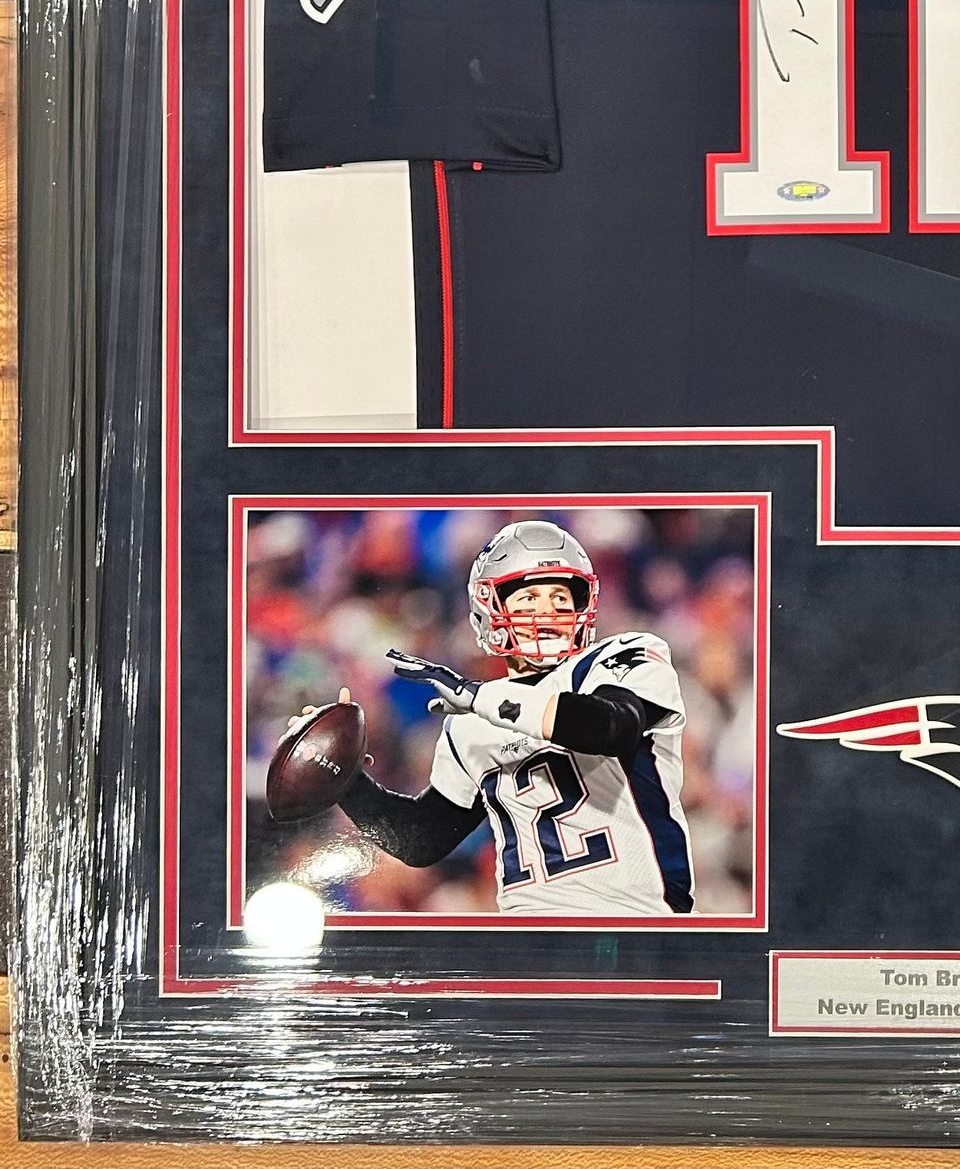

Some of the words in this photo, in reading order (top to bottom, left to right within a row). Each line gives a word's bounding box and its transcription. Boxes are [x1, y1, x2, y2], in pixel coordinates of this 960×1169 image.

[479, 745, 619, 893] 12
[880, 969, 928, 987] Tom
[817, 998, 869, 1015] New
